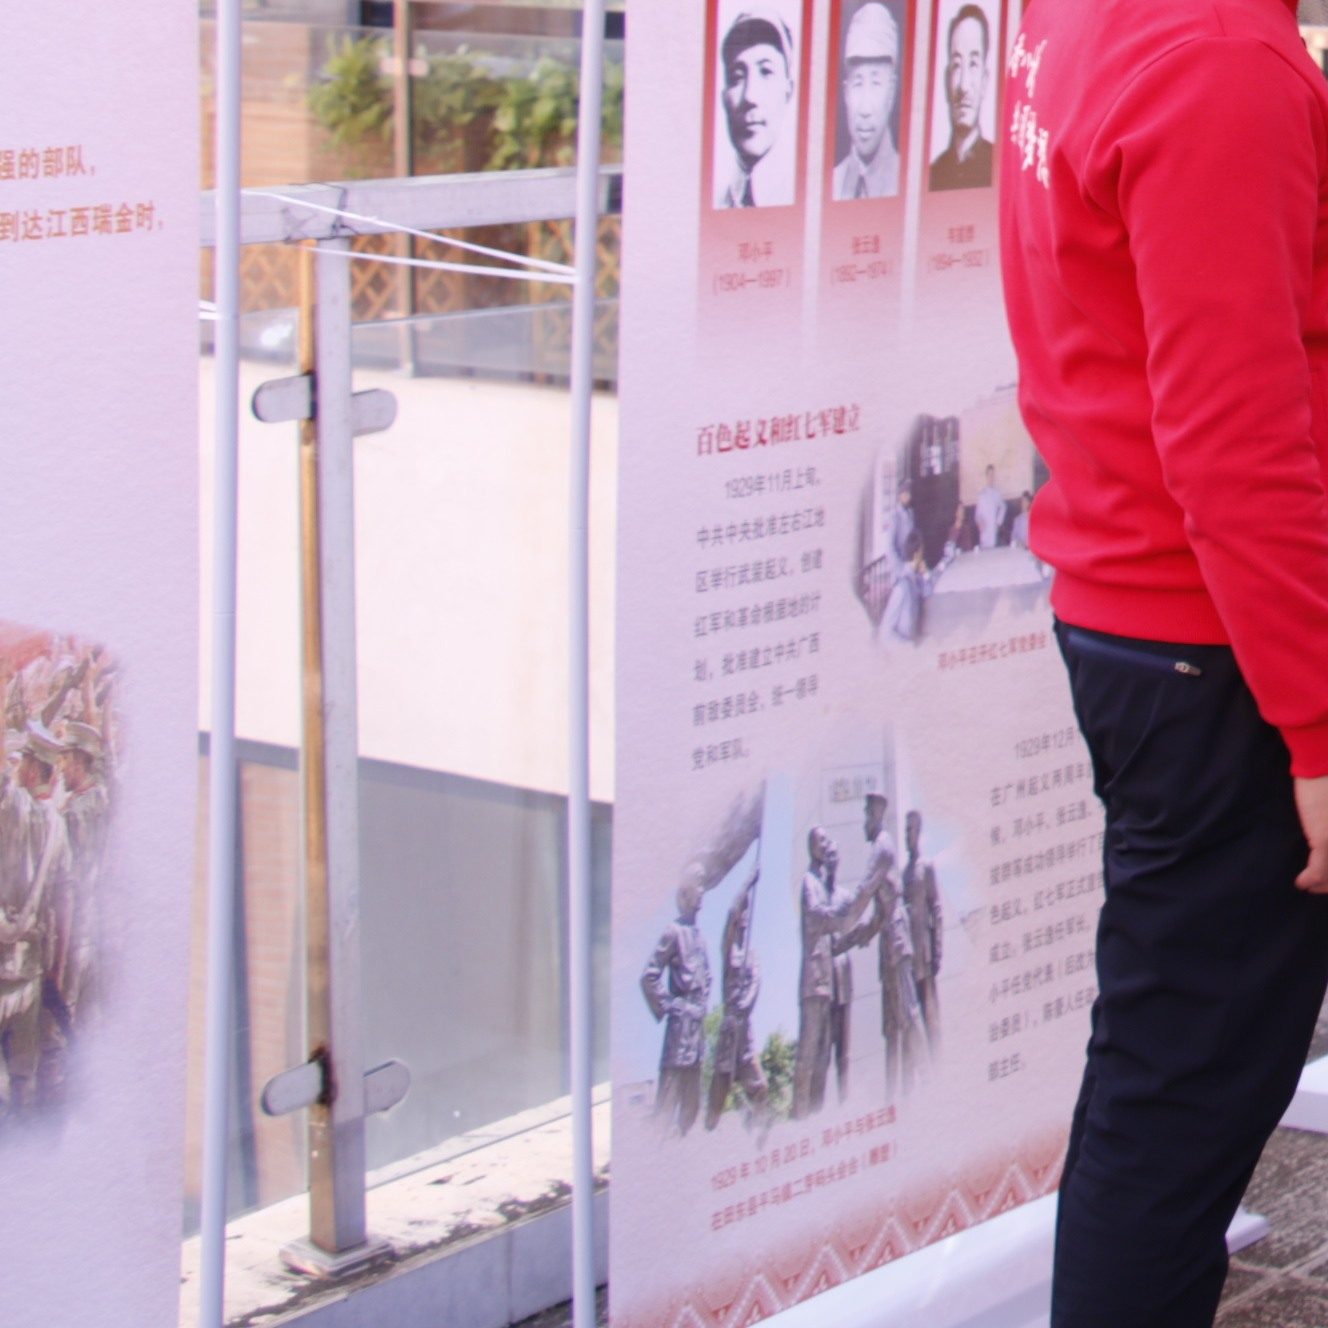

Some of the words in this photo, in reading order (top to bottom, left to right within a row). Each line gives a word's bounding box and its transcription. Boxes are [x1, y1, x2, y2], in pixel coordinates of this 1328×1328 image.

[0, 200, 164, 242] 到达江西瑞金时，
[697, 404, 862, 457] 百色起义和红七军建立
[695, 505, 826, 548] 中共中央批准左右江地
